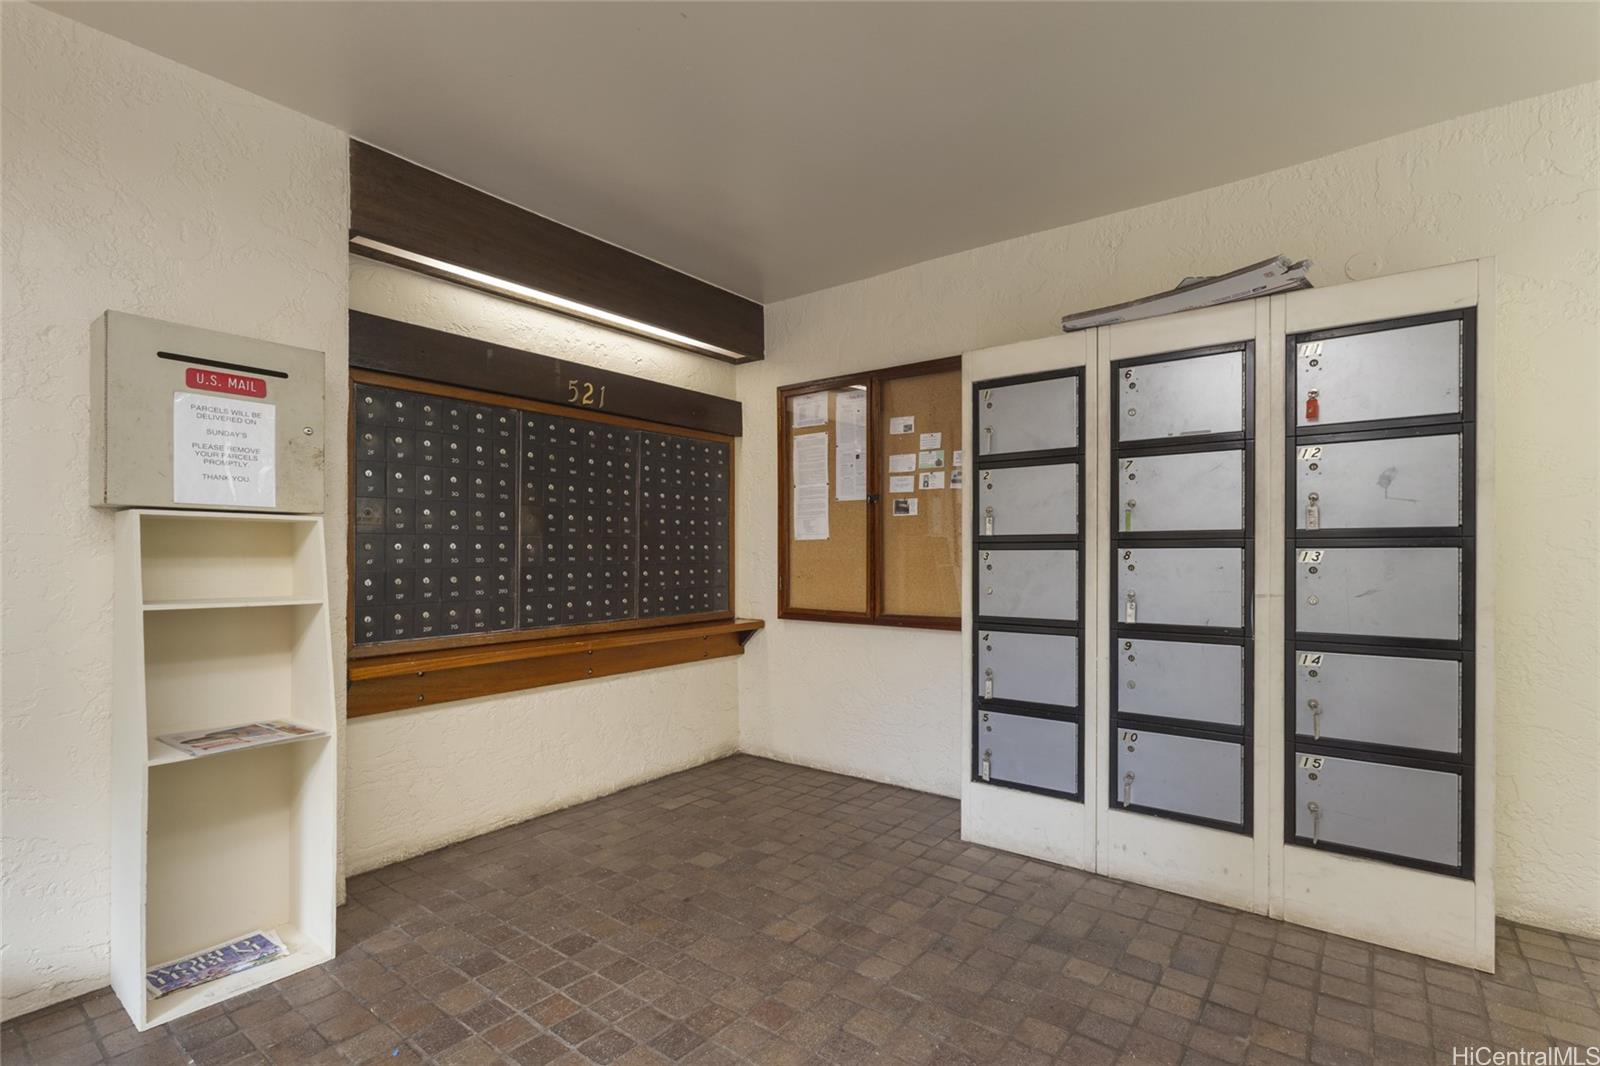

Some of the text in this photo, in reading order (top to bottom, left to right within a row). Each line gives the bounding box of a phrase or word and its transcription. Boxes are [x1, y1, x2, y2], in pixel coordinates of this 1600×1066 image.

[1302, 344, 1321, 356] 11
[1124, 369, 1132, 379] 6
[196, 373, 257, 392] U.S. MAIL
[567, 379, 606, 408] 521
[983, 391, 990, 400] 1
[190, 404, 262, 419] PARCELS WILL BE
[196, 412, 243, 424] DELIVERED
[206, 428, 248, 439] SUNDAY'S
[191, 442, 225, 452] PLEASE
[194, 450, 258, 462] YOUR PARCELS
[1302, 448, 1321, 459] 12
[1124, 460, 1133, 470] 7
[202, 473, 229, 481] THANK
[983, 471, 990, 480] 2
[983, 552, 990, 561] 3
[1123, 551, 1132, 560] 8
[1302, 551, 1321, 562] 13
[982, 634, 990, 642] 4
[1124, 641, 1132, 651] 9
[1302, 654, 1321, 666] 14
[982, 713, 990, 722] 5
[1122, 731, 1138, 742] 10
[1302, 757, 1322, 769] 15
